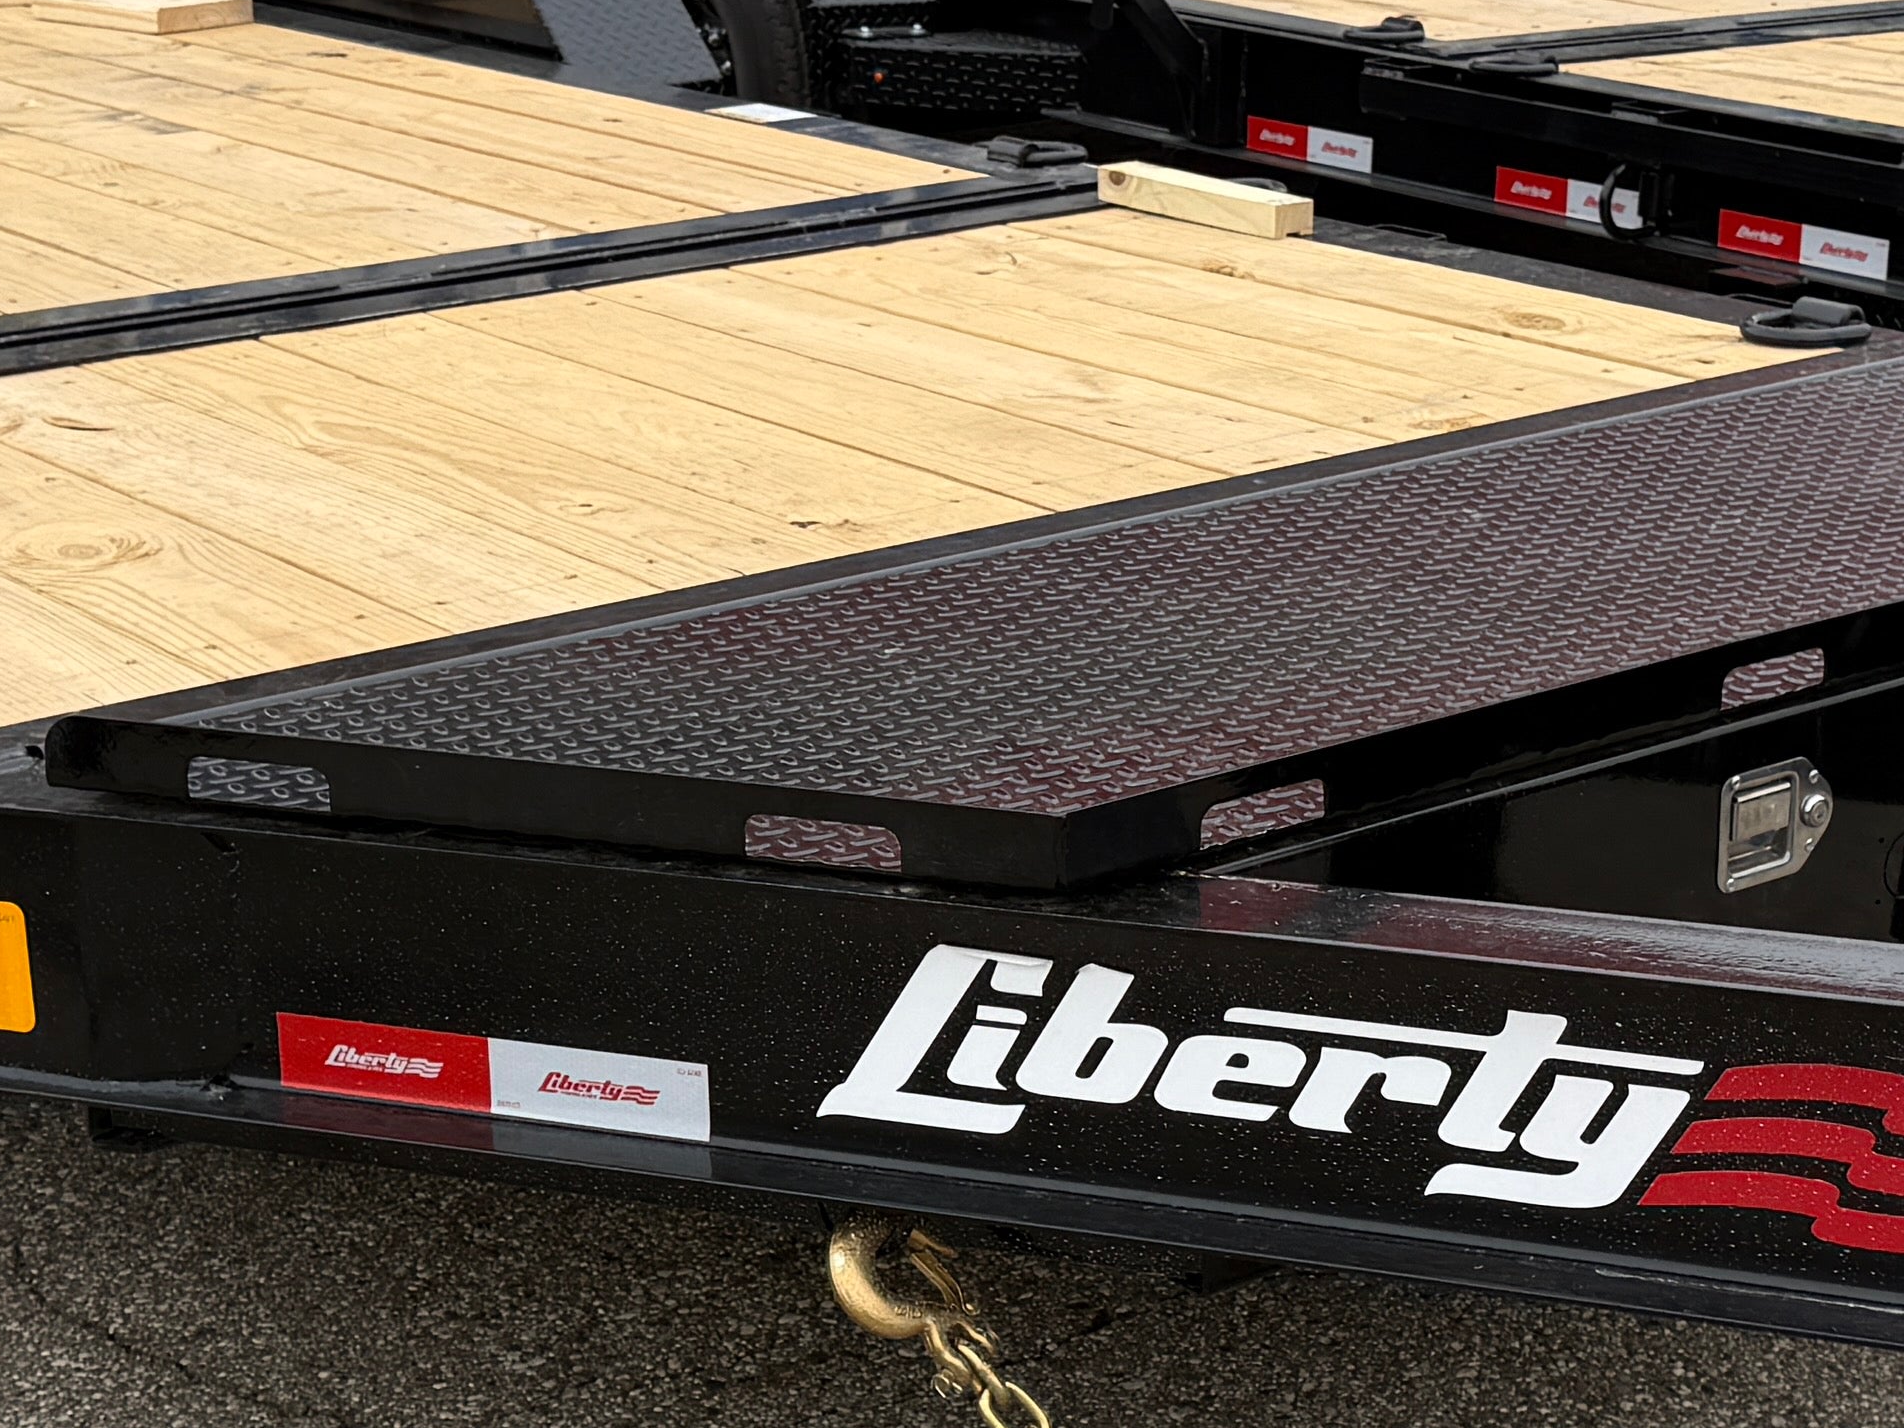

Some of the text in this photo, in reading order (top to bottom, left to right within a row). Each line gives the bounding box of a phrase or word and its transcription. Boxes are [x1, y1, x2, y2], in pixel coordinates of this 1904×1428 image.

[325, 1044, 410, 1074] Liberty
[538, 1072, 624, 1101] Liberty
[816, 943, 1705, 1210] Liberty
